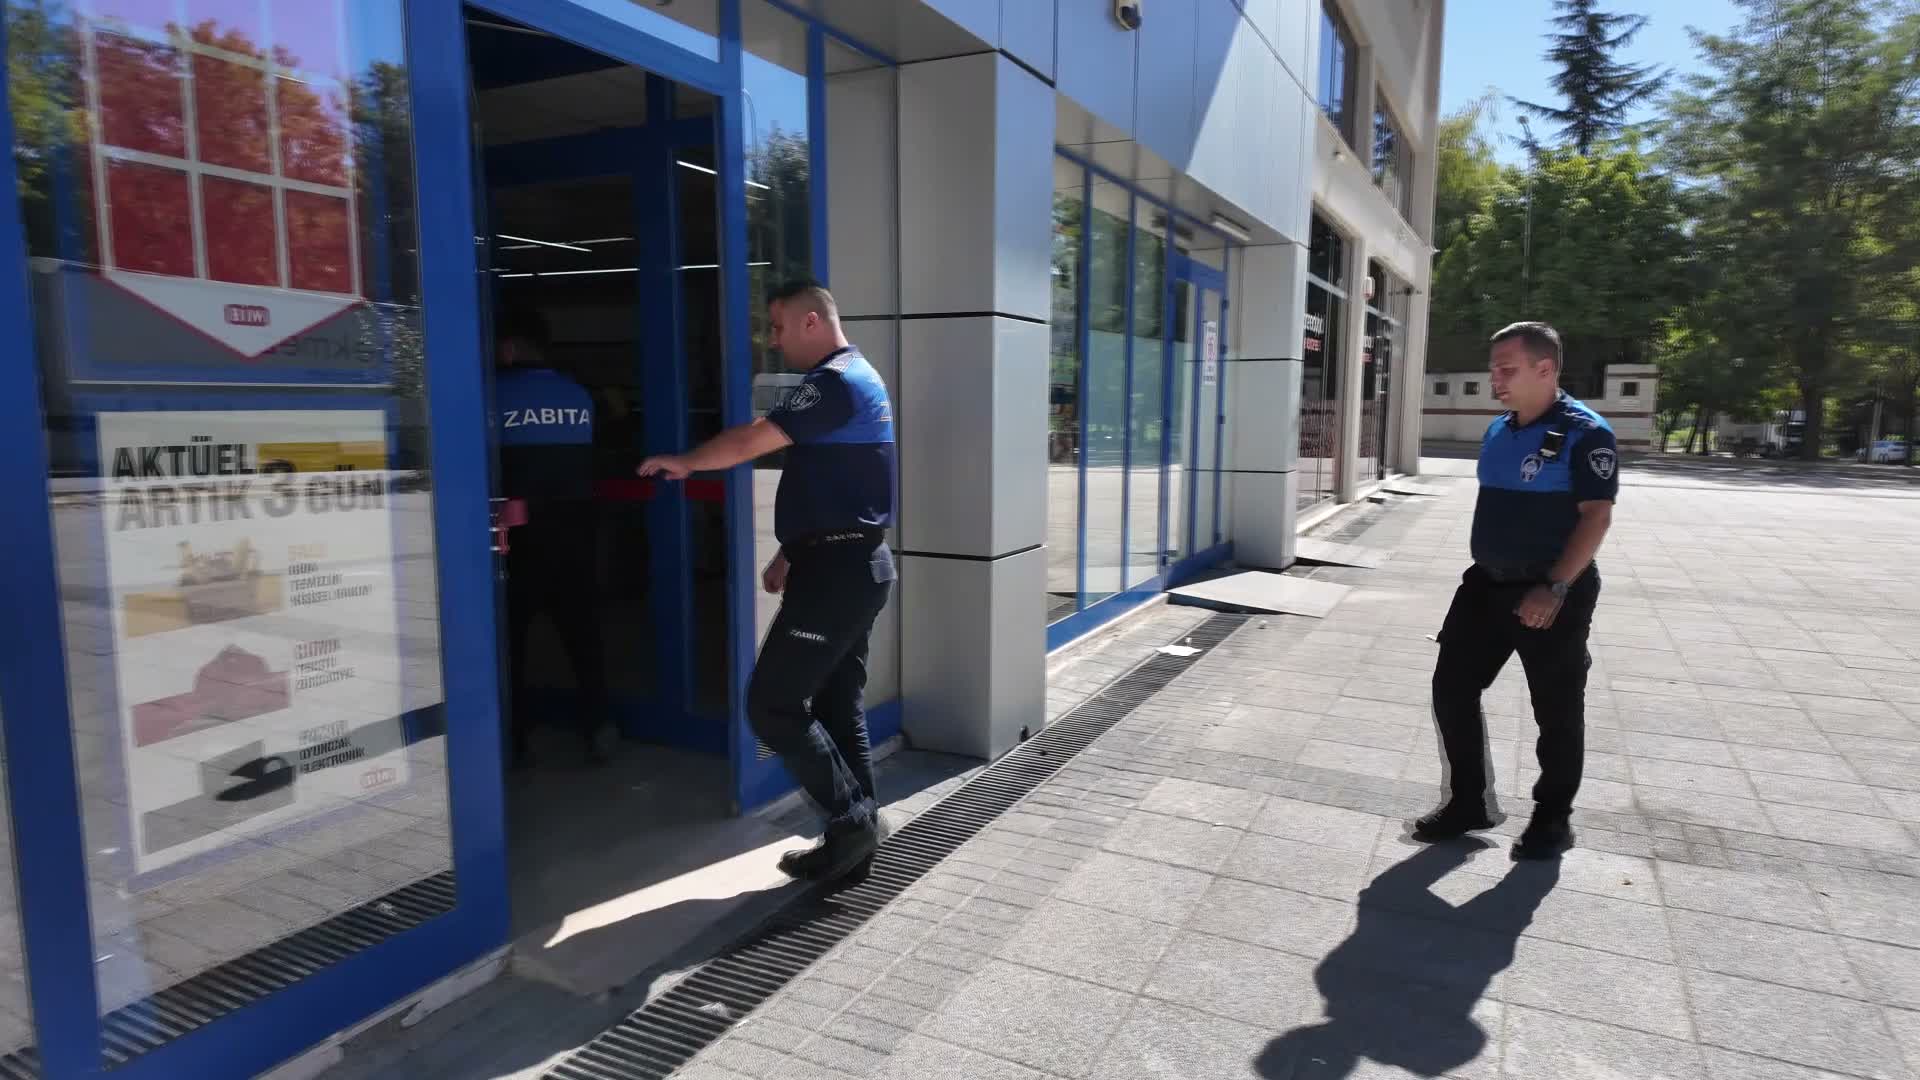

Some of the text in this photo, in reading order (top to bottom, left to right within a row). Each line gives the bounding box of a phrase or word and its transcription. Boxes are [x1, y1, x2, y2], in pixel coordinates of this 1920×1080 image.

[503, 407, 591, 428] ZABITA
[111, 435, 256, 482] AKTÜEL
[115, 459, 385, 531] ARTIK 3 GÜN
